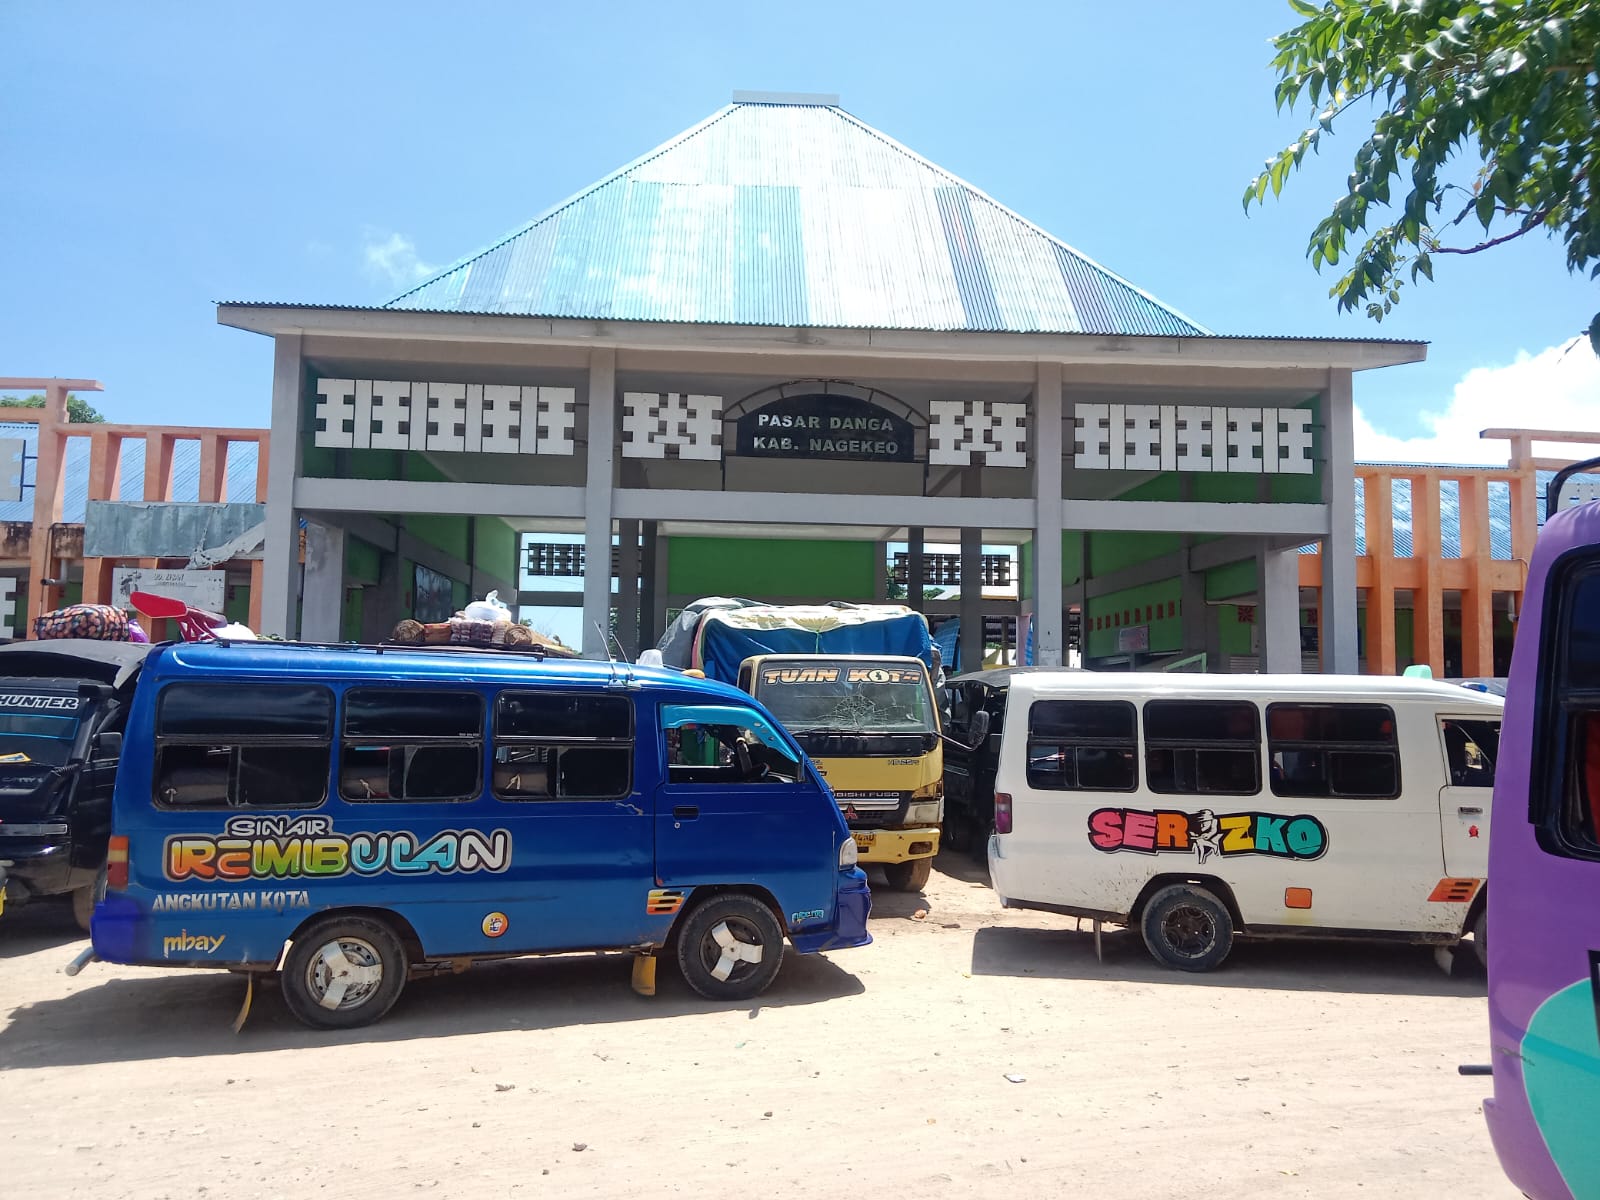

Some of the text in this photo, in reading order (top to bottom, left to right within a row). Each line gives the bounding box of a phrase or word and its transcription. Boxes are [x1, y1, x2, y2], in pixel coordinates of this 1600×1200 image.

[758, 414, 893, 432] PASAR DANGA
[753, 436, 899, 455] KAB. NAGEKEO
[763, 667, 840, 684] TUAN
[0, 694, 80, 710] HUNTER
[166, 830, 510, 879] REMBULAN
[152, 890, 310, 912] ANGKUTAN KOTA
